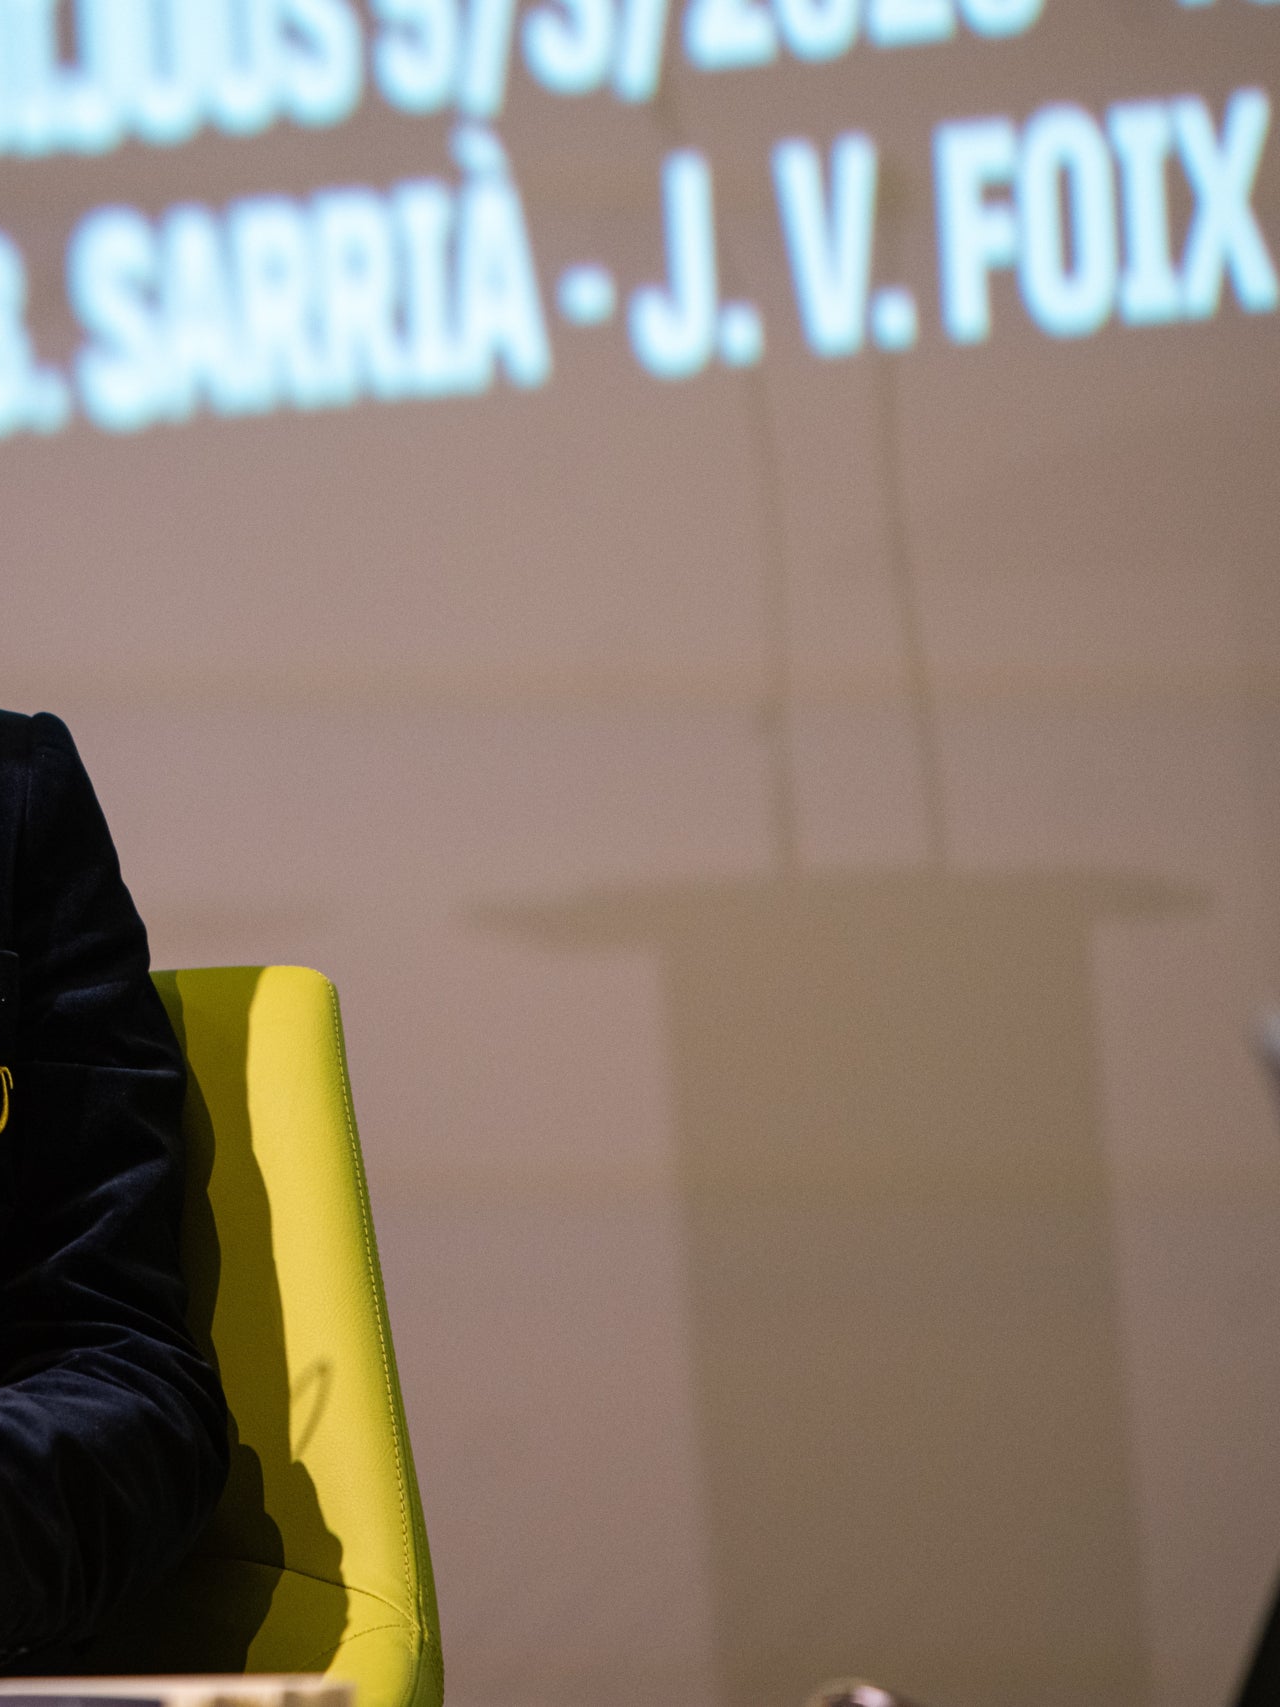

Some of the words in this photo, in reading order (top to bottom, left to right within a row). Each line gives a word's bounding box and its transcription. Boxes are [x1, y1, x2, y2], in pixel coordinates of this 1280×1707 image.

[69, 122, 551, 434] SARRIÀ
[629, 149, 763, 380] J.
[772, 130, 916, 357] V.
[932, 88, 1277, 344] FOIX
